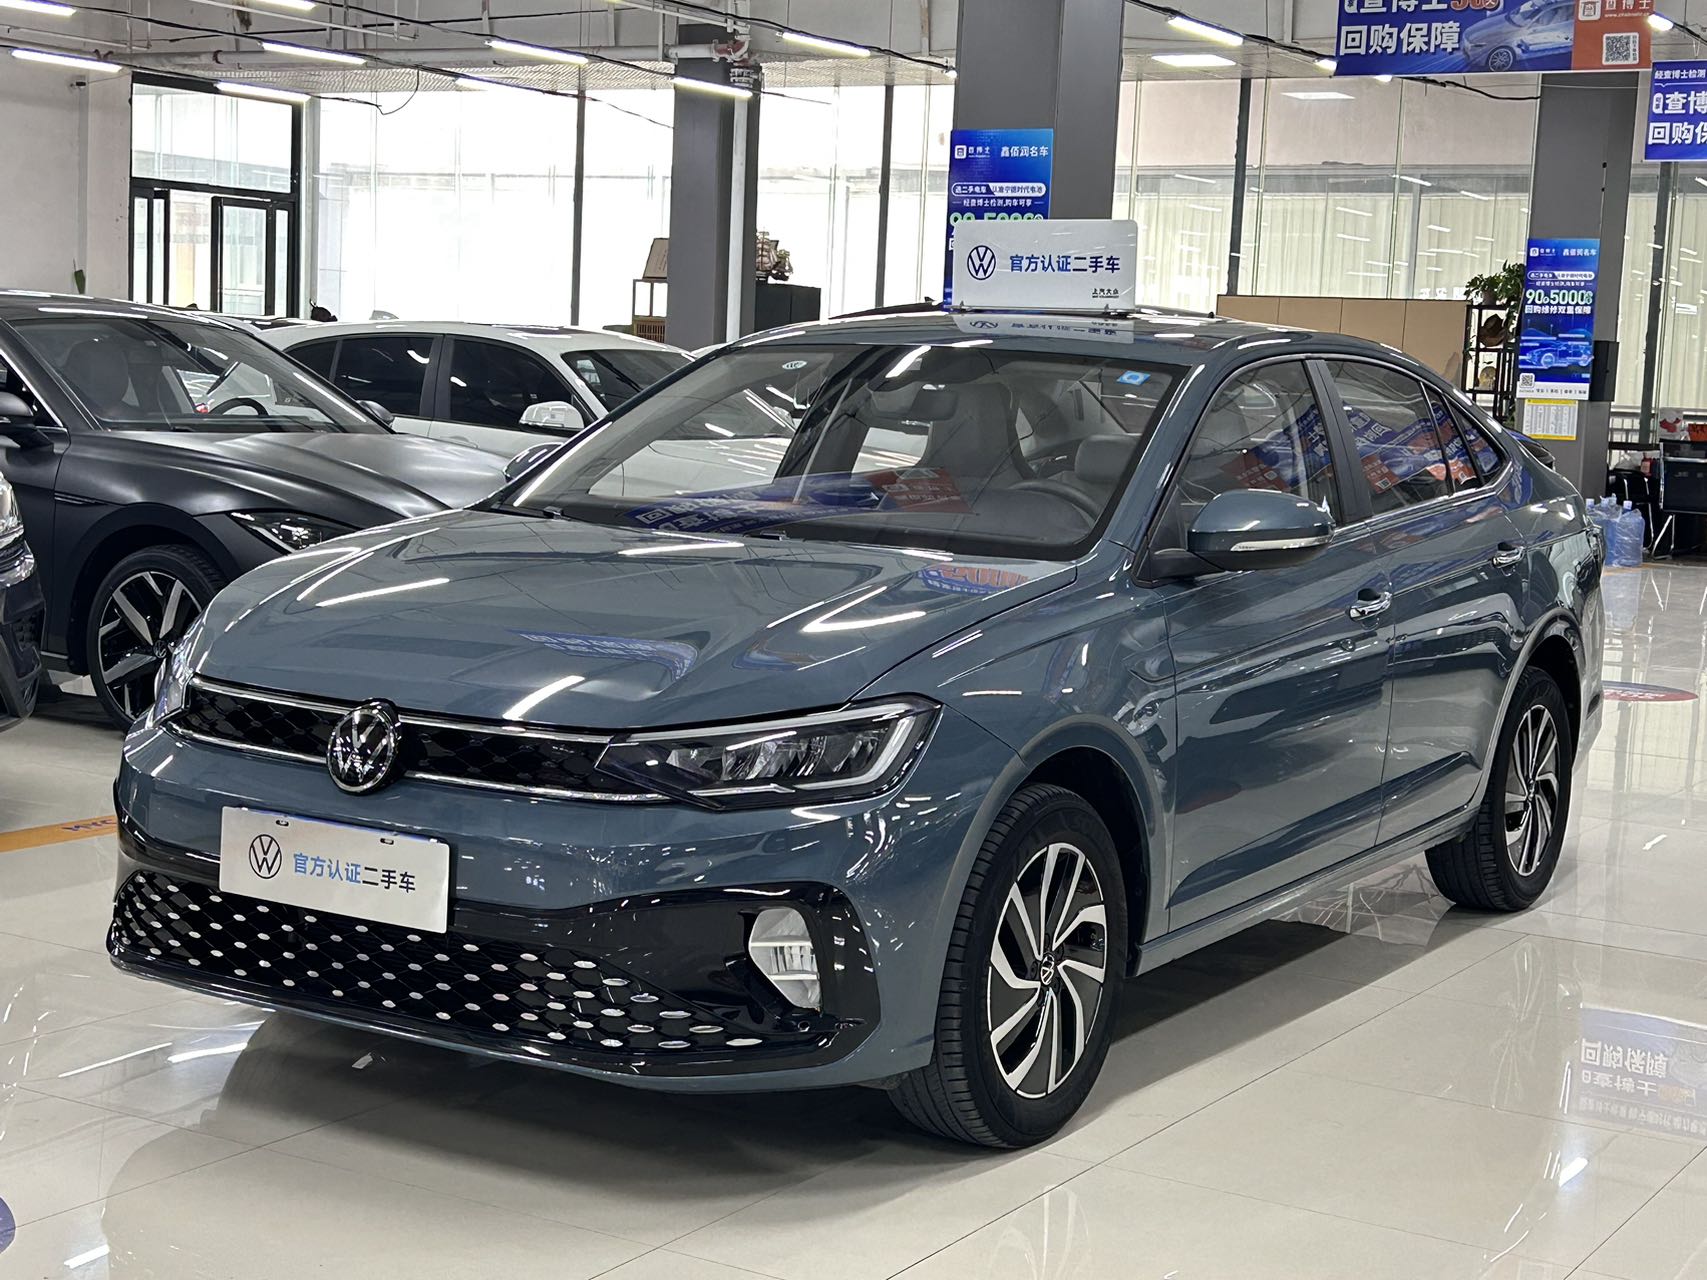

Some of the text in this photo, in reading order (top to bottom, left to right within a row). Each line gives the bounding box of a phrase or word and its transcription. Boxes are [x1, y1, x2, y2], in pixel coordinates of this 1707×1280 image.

[1340, 21, 1460, 56] 回购保障
[1009, 254, 1121, 274] 官方认证二手车
[293, 852, 416, 893] 官方认证二手车
